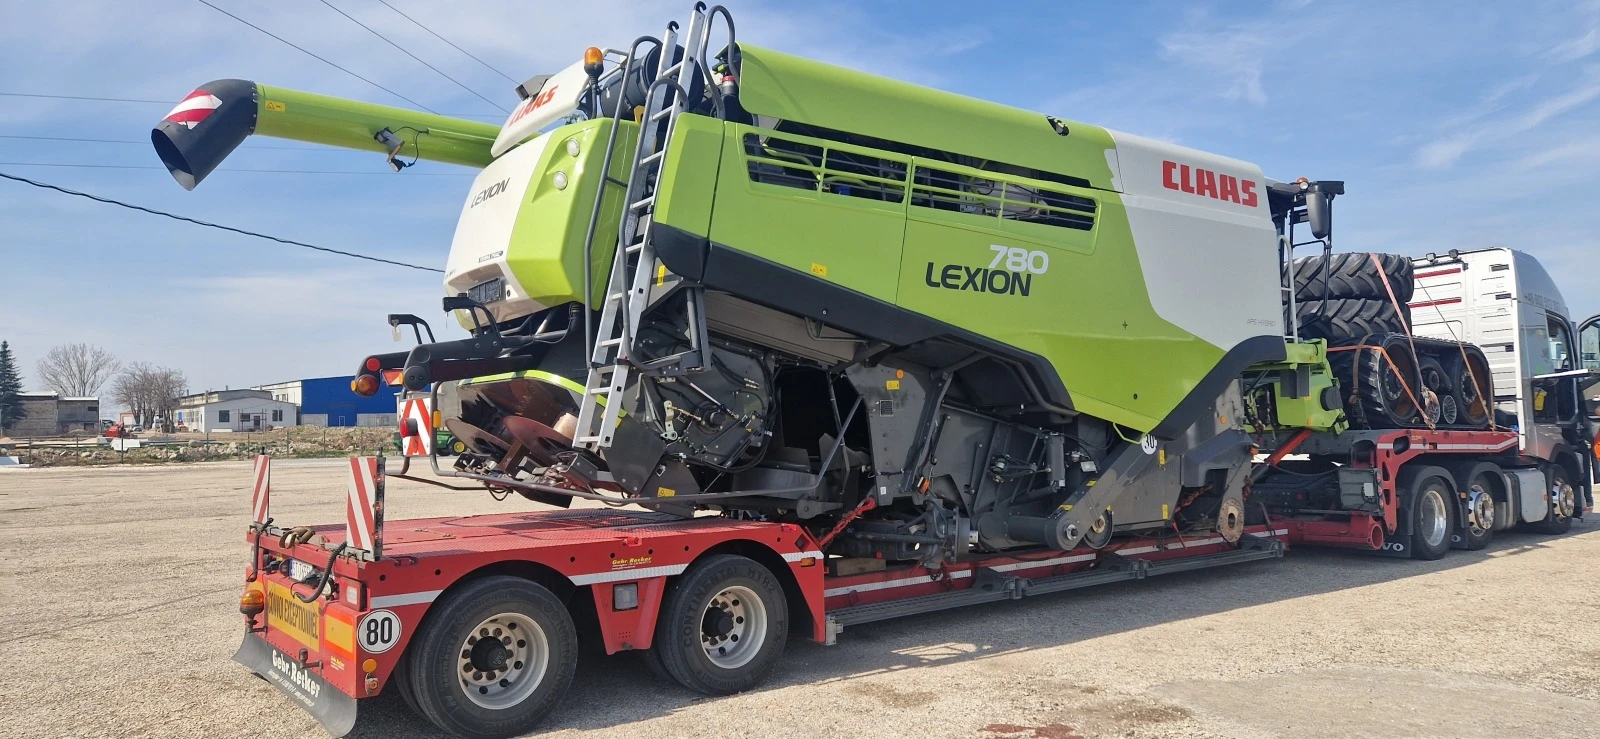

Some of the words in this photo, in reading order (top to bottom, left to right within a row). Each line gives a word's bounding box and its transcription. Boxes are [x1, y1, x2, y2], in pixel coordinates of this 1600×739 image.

[508, 85, 559, 128] CLAAS
[470, 177, 510, 208] LEXION
[1162, 160, 1258, 207] CLAAS
[988, 244, 1049, 274] 780
[925, 262, 1032, 297] LEXION
[284, 598, 319, 640] EXCEPTIONNEL
[366, 616, 393, 646] 80
[272, 649, 291, 677] Gebr.
